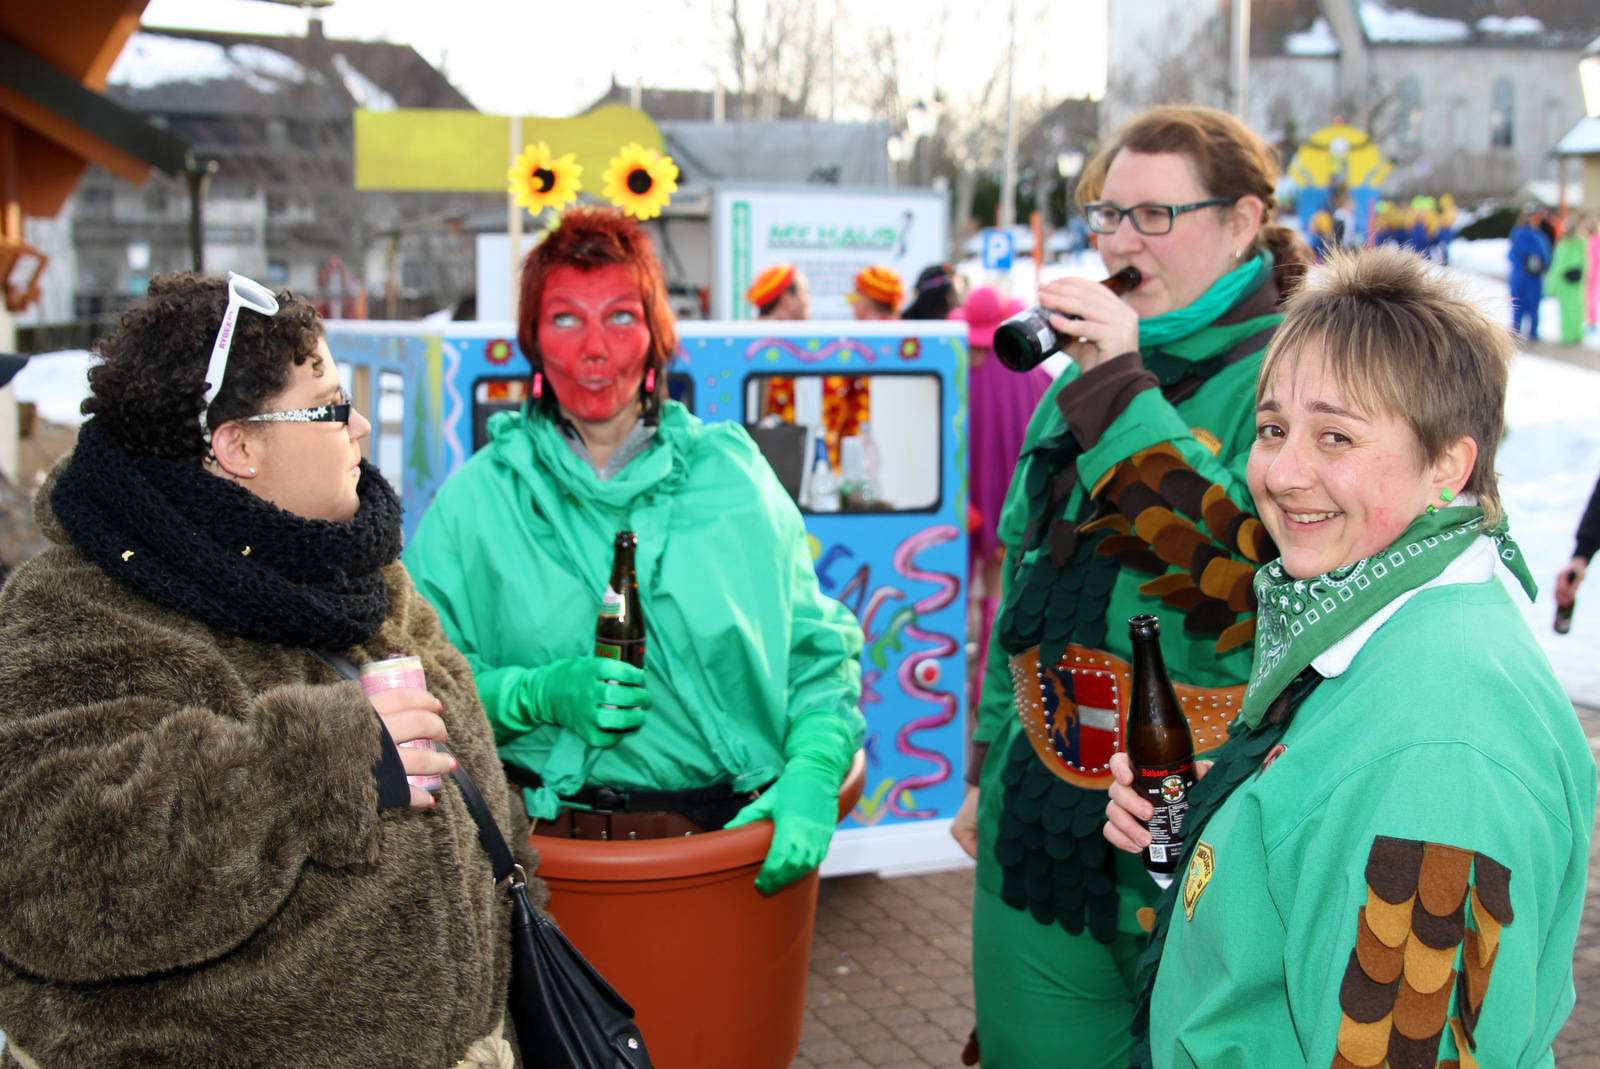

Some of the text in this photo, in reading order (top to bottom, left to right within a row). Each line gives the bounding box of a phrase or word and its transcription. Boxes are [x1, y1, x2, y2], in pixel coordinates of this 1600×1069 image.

[988, 232, 1008, 267] P
[219, 321, 232, 349] RYDEX
[1141, 768, 1168, 777] Rothaus
